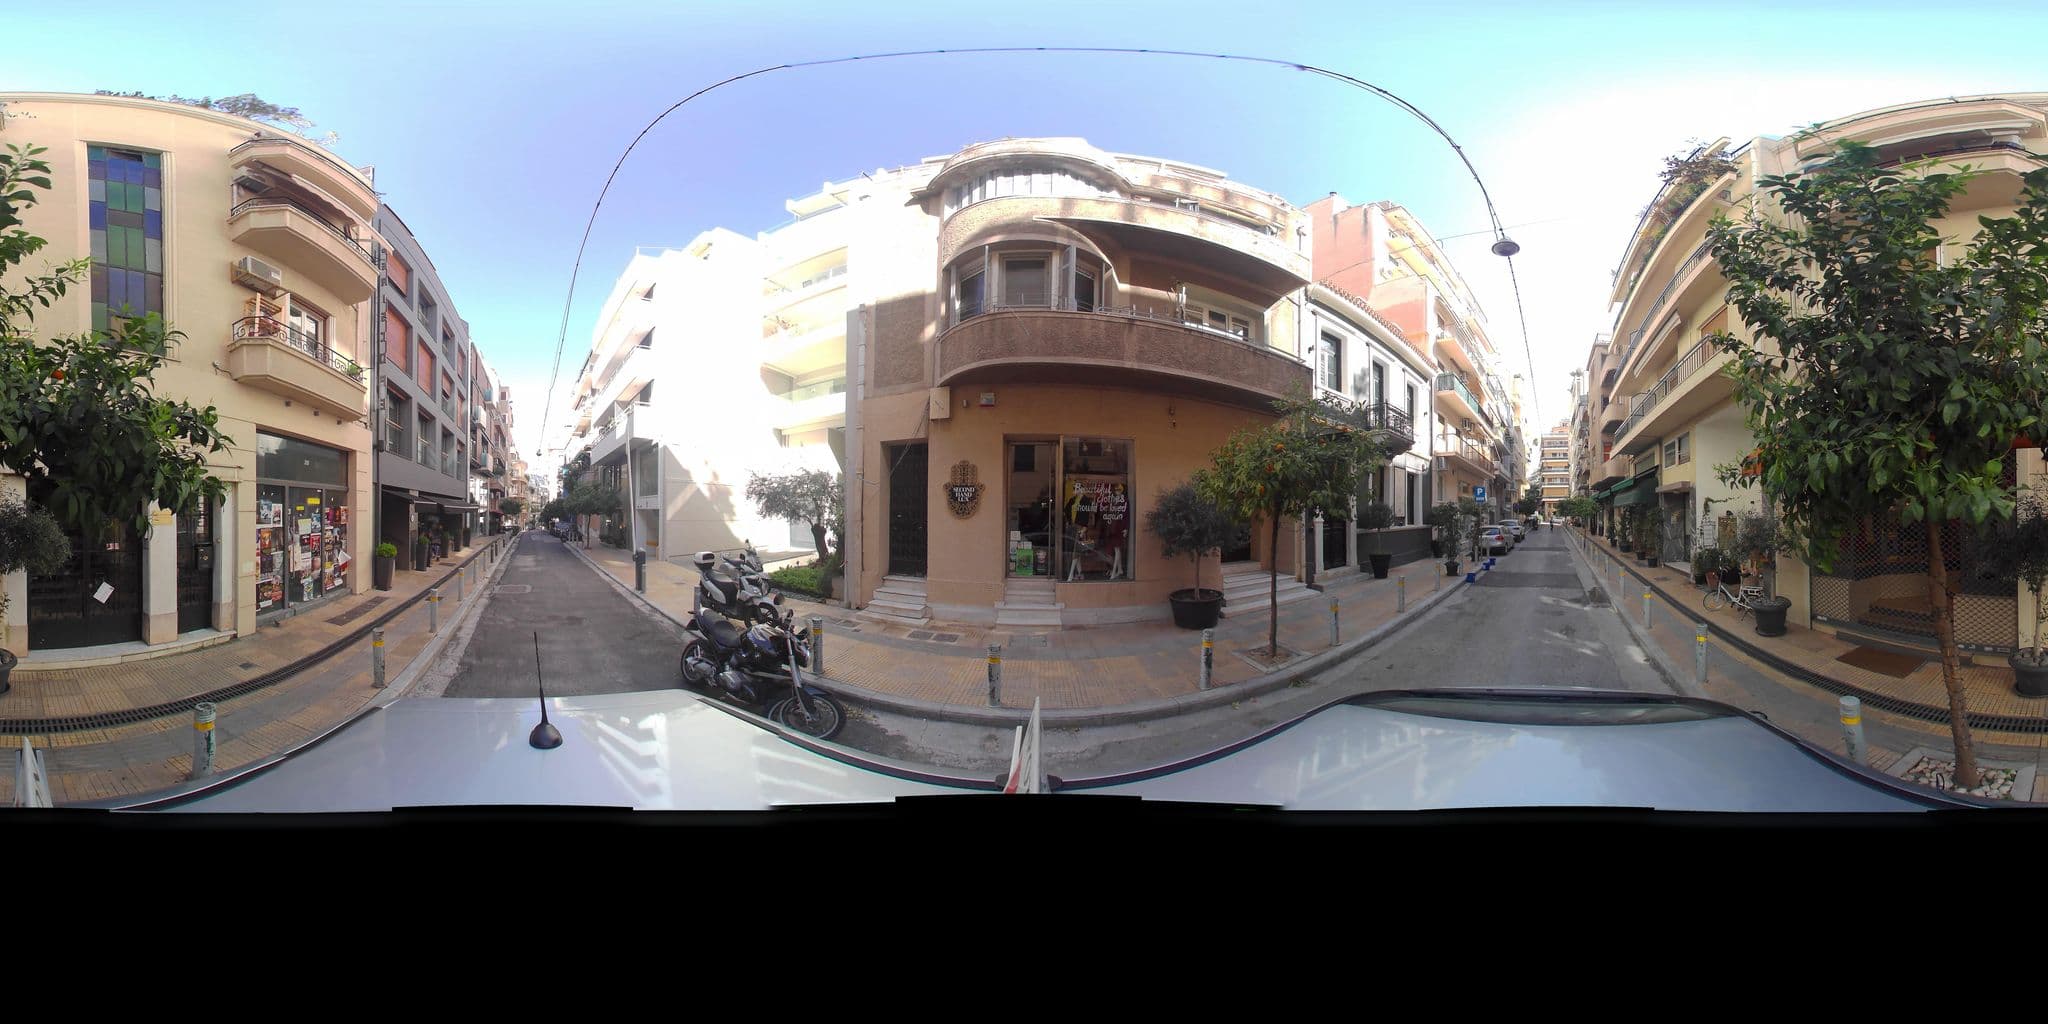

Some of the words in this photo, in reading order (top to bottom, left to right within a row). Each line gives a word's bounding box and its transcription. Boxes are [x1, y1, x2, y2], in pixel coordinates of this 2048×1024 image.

[1074, 483, 1112, 495] Beautiful
[1097, 494, 1125, 503] clothes
[1099, 502, 1108, 511] be
[1109, 502, 1127, 512] loved
[1102, 513, 1123, 524] again
